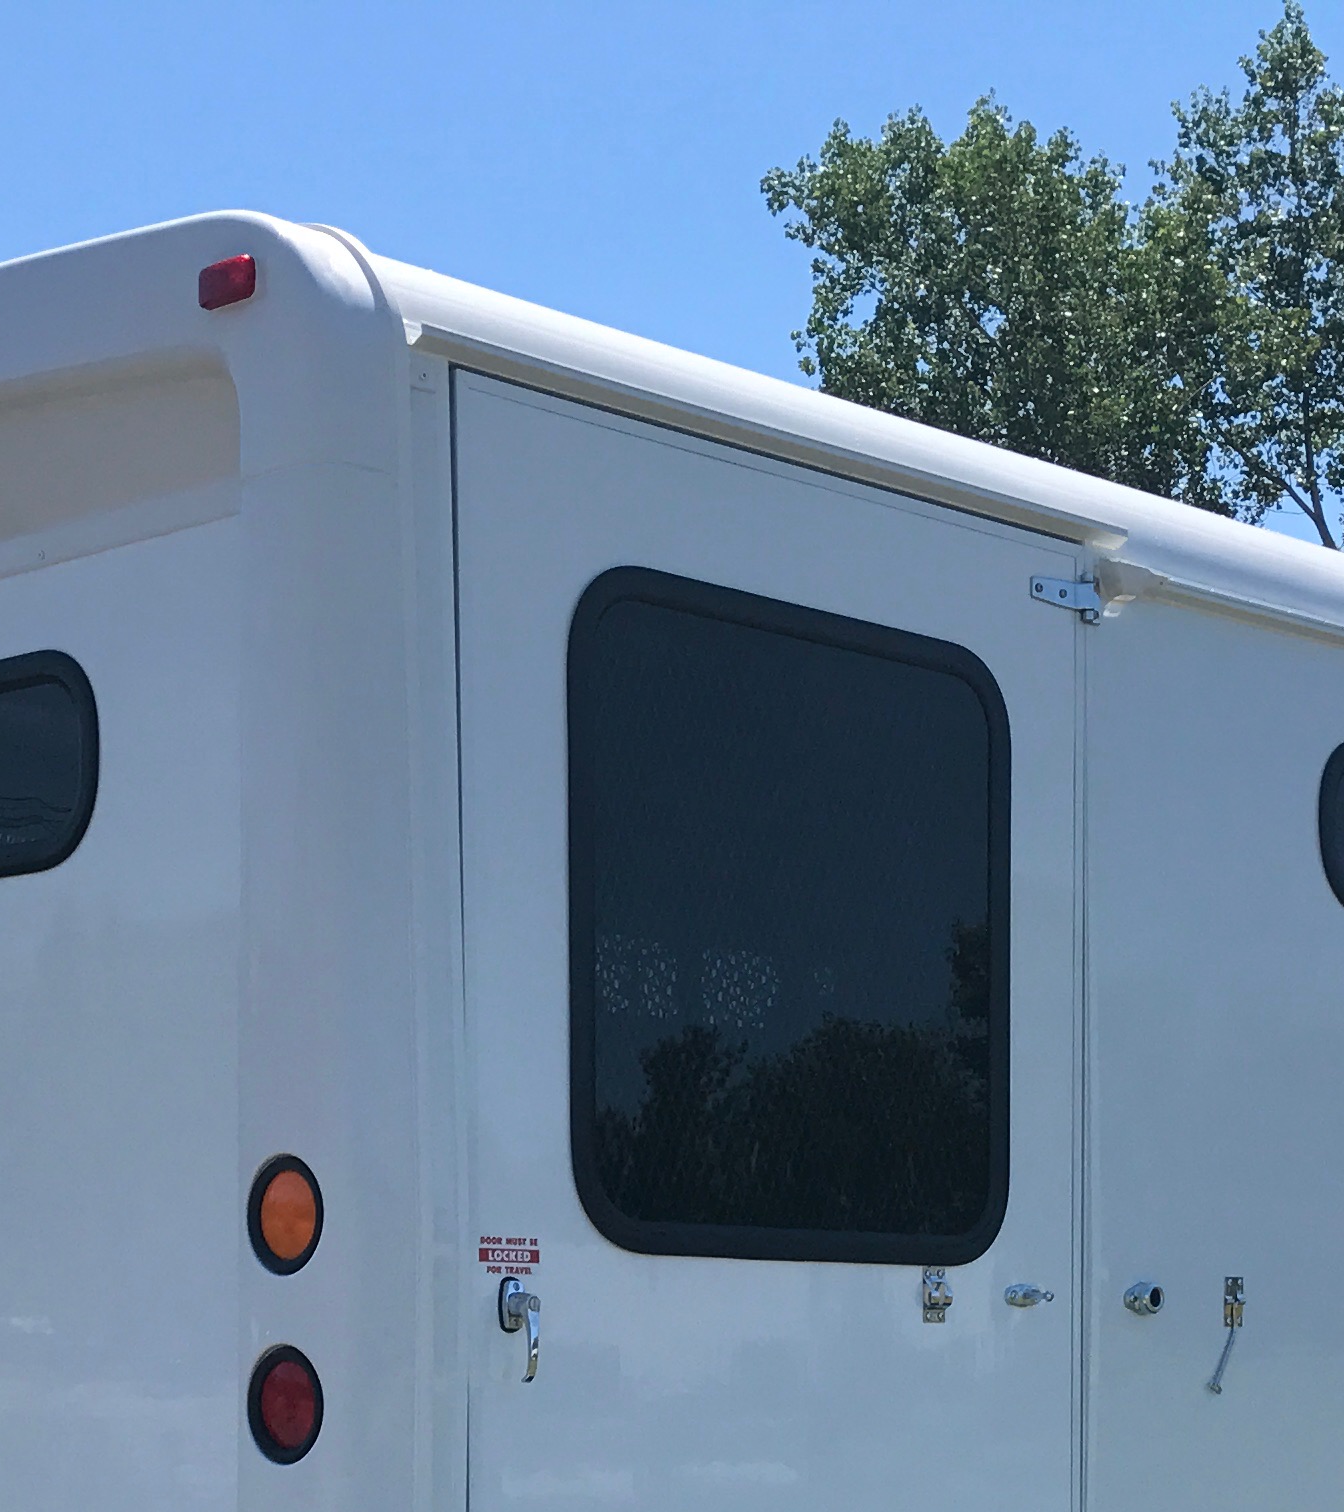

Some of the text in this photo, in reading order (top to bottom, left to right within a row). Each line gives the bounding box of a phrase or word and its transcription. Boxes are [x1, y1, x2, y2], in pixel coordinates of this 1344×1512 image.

[479, 1236, 538, 1246] DOOR MUST BE
[488, 1249, 531, 1262] LOCKED
[486, 1265, 532, 1275] FOR TRAVEL
